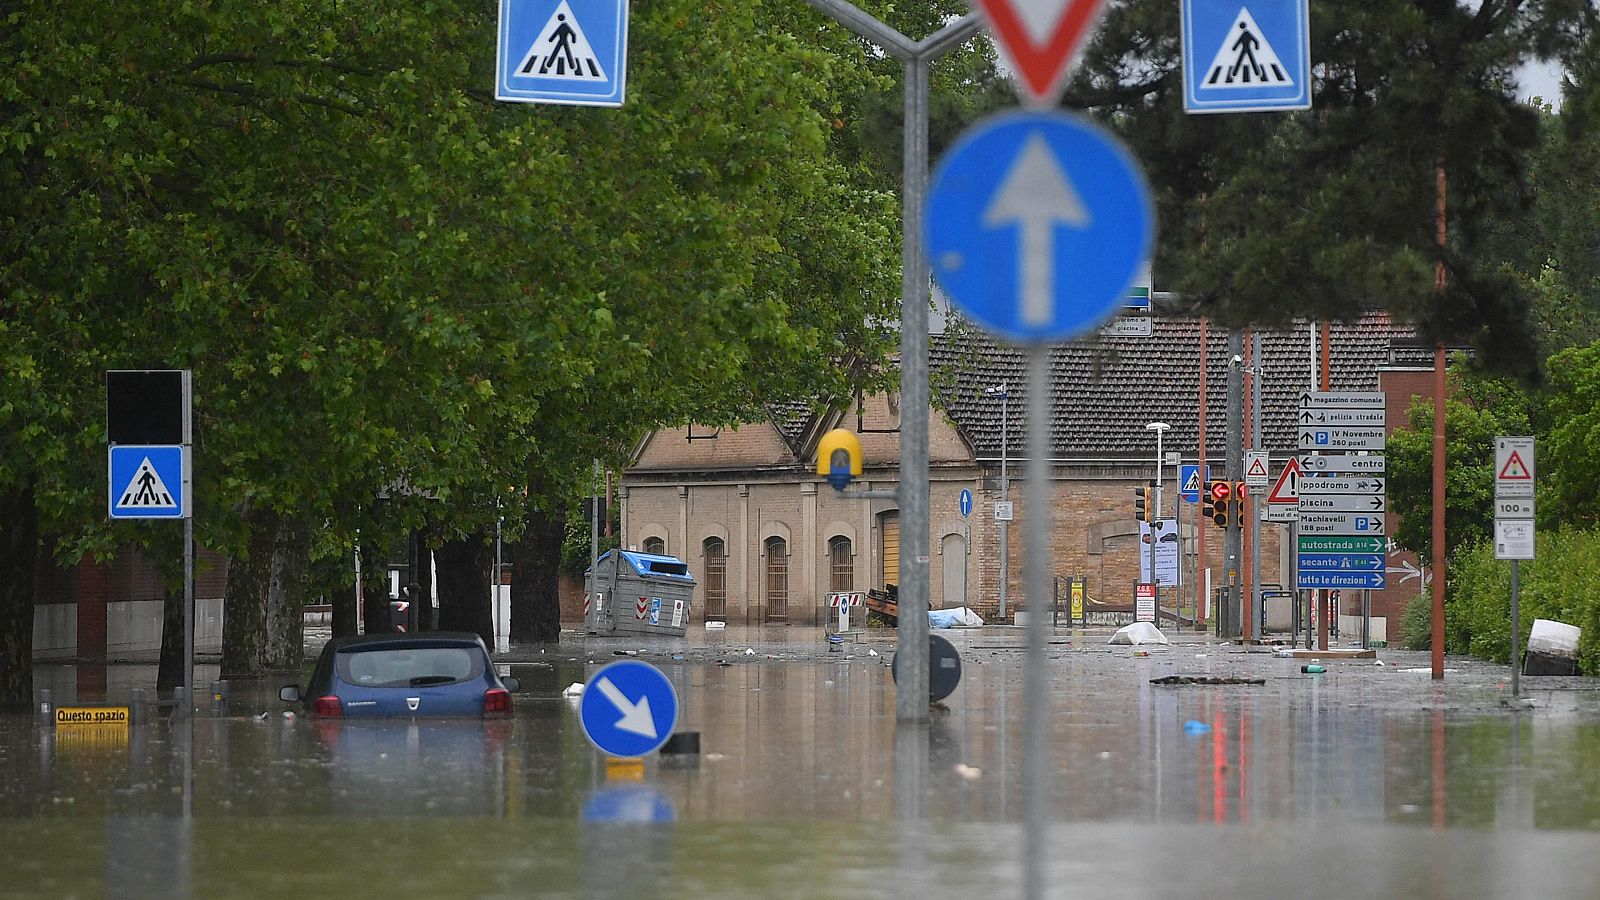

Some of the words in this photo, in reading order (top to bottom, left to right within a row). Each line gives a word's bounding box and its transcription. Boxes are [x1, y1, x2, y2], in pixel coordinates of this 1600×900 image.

[1300, 481, 1349, 489] ippodromo
[1300, 499, 1334, 507] piscina
[1501, 504, 1520, 512] 100
[1301, 541, 1353, 549] autostrada
[1298, 575, 1320, 584] tutte
[1321, 575, 1330, 584] le
[1331, 575, 1367, 584] direzioni
[57, 710, 92, 722] Questo
[95, 709, 125, 724] spazio
